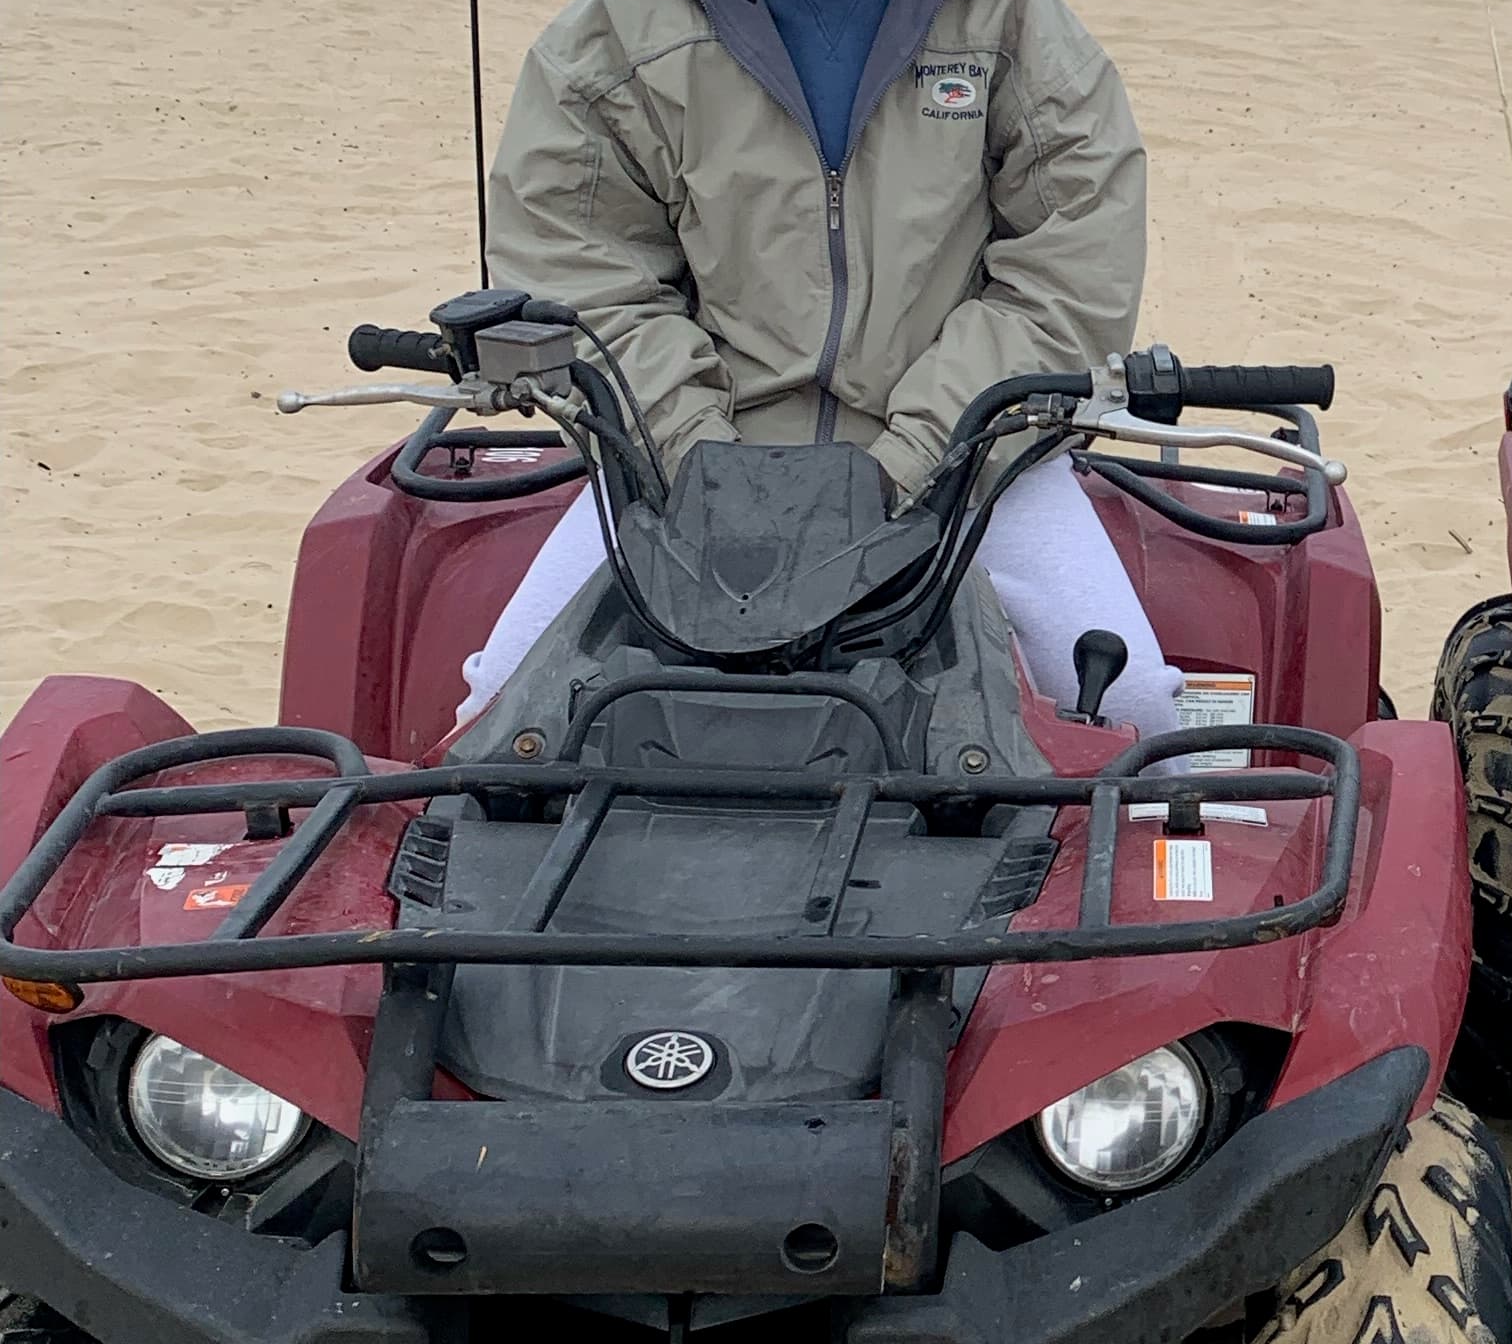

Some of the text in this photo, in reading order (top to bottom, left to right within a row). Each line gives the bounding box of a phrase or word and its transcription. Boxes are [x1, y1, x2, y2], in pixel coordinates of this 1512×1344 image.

[915, 61, 989, 89] MONTEREY BAY
[921, 107, 984, 121] CALIFORNIA
[481, 447, 544, 463] 106
